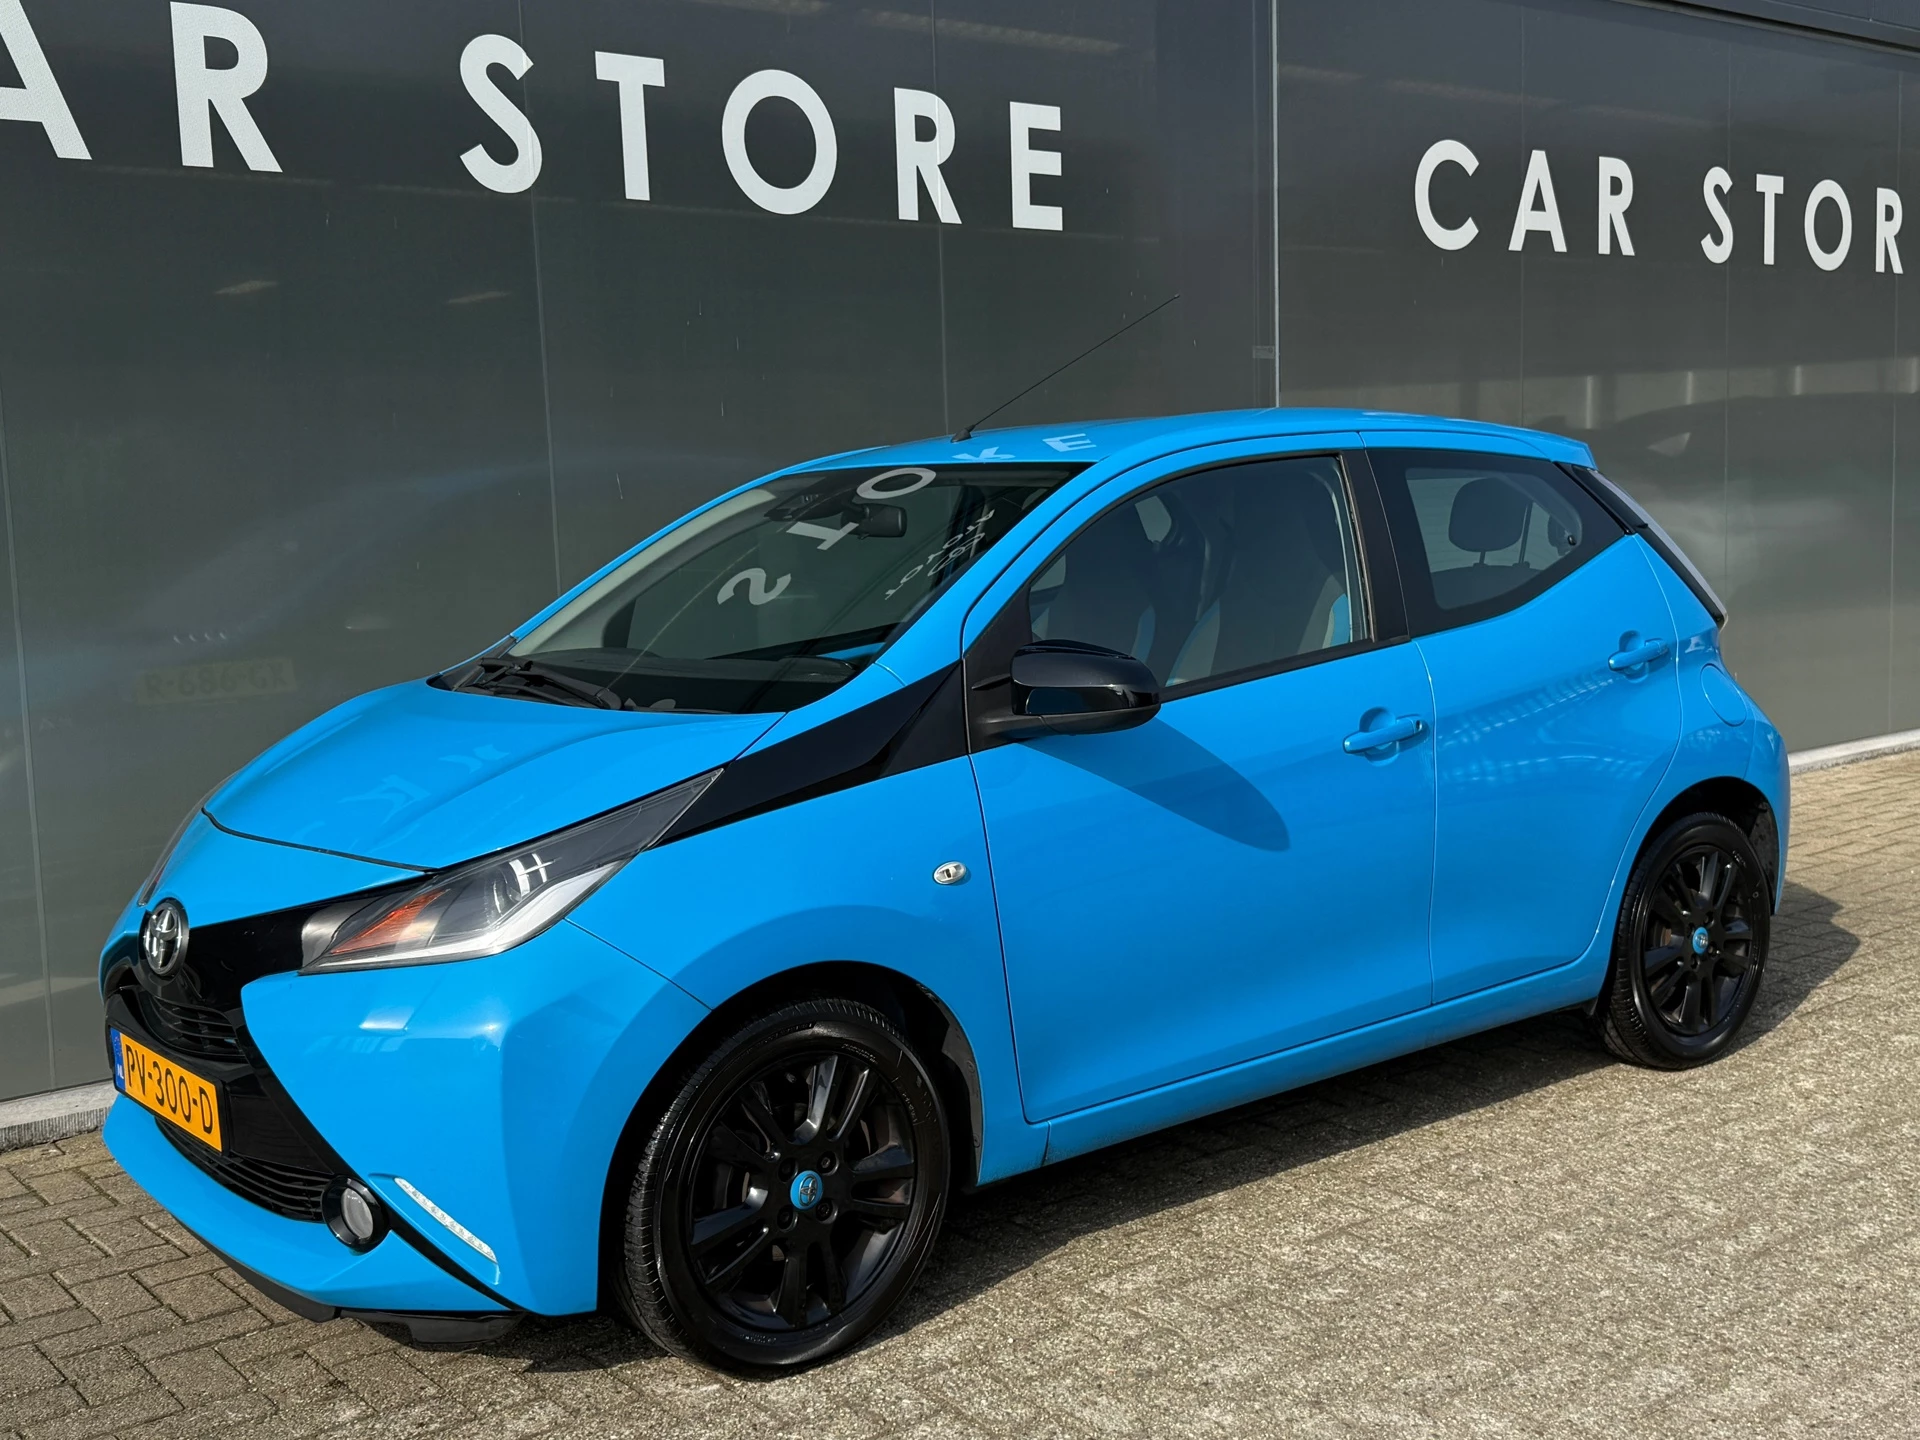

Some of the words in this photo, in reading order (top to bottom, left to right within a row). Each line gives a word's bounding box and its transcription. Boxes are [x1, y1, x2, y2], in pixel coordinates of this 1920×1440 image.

[460, 34, 1063, 231] STORE
[1415, 139, 1635, 256] CAR
[1701, 166, 1904, 274] STOR
[126, 1045, 213, 1134] PV-300-D
